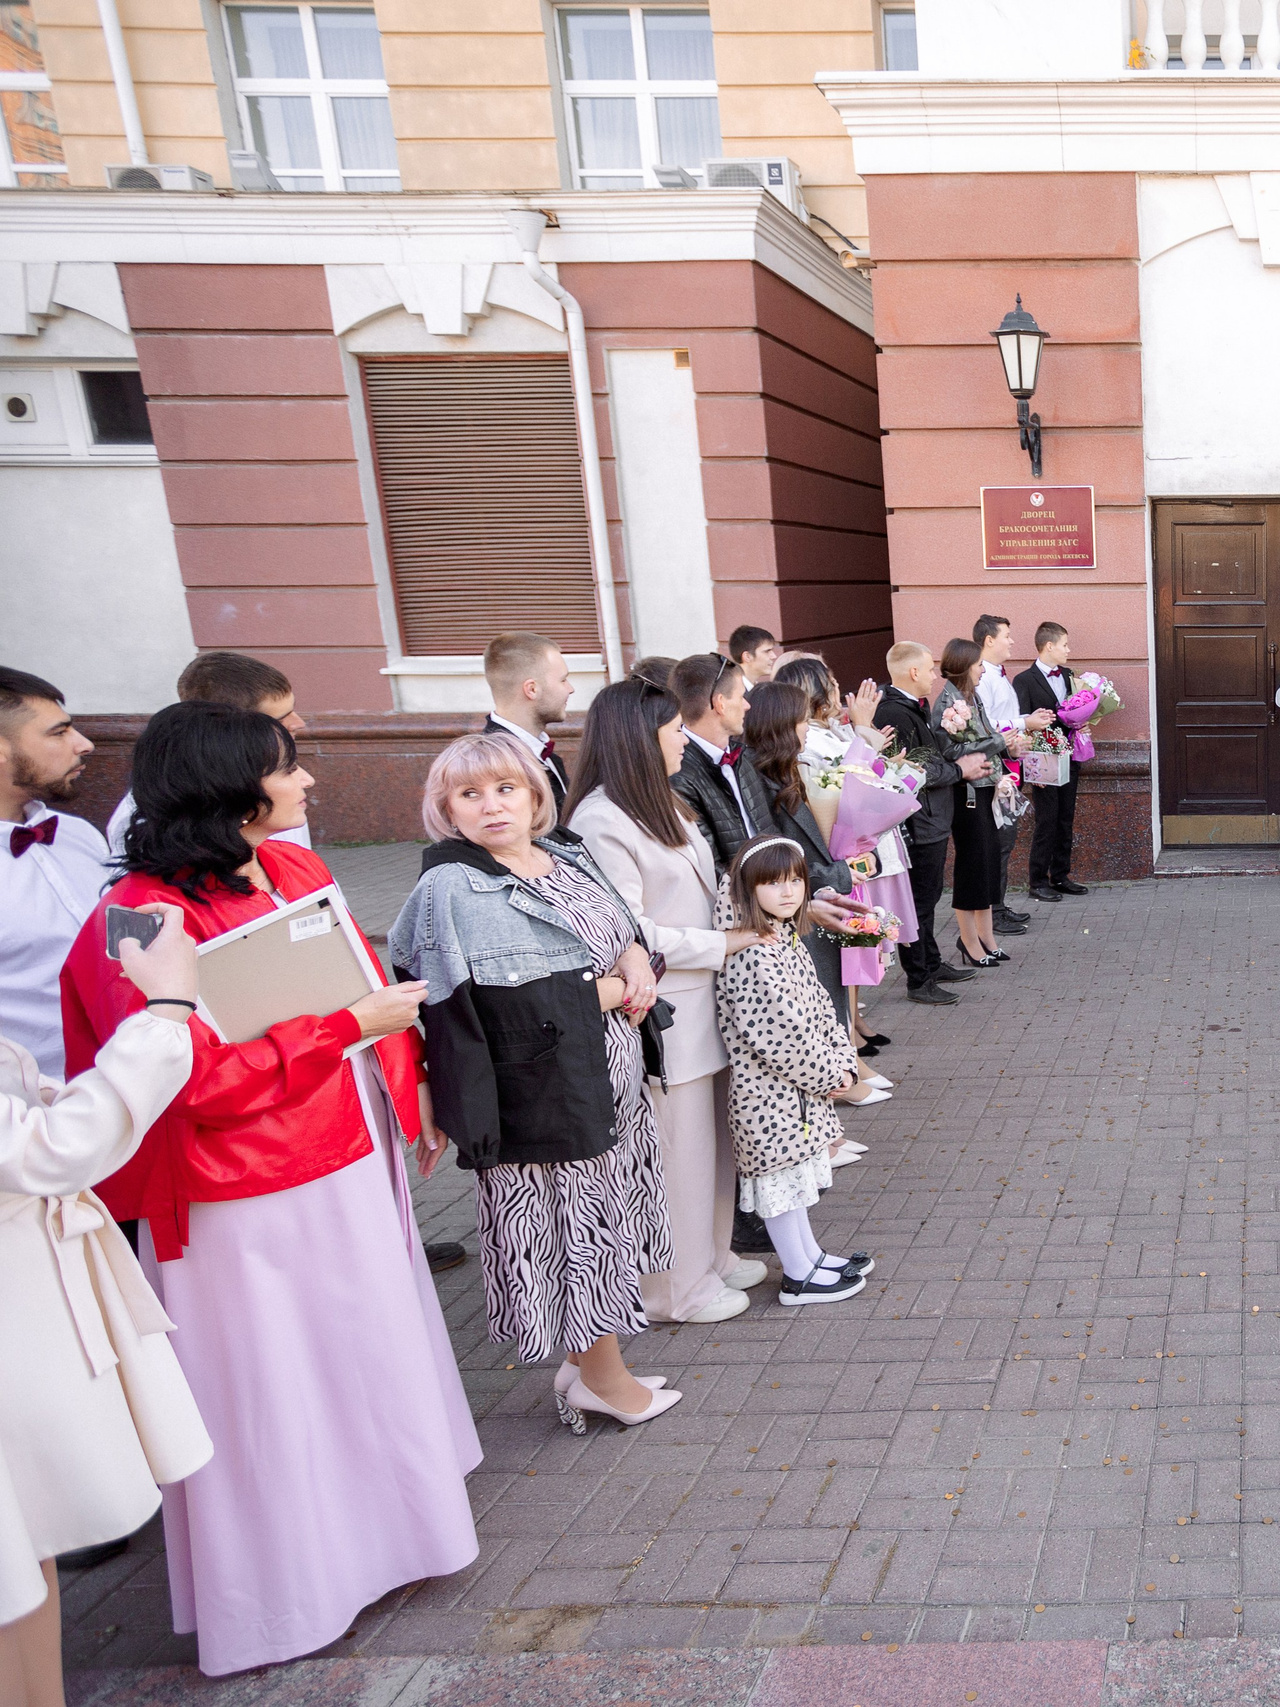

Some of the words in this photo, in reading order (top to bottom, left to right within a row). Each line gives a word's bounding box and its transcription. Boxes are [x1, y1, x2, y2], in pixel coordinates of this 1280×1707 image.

[1021, 511, 1055, 519] ДВОРЕЦ
[999, 525, 1078, 533] БРАКОСОЧЕТАНИЯ
[999, 539, 1056, 547] УПРАВЛЕНИЯ
[1058, 538, 1079, 546] ЗАГС
